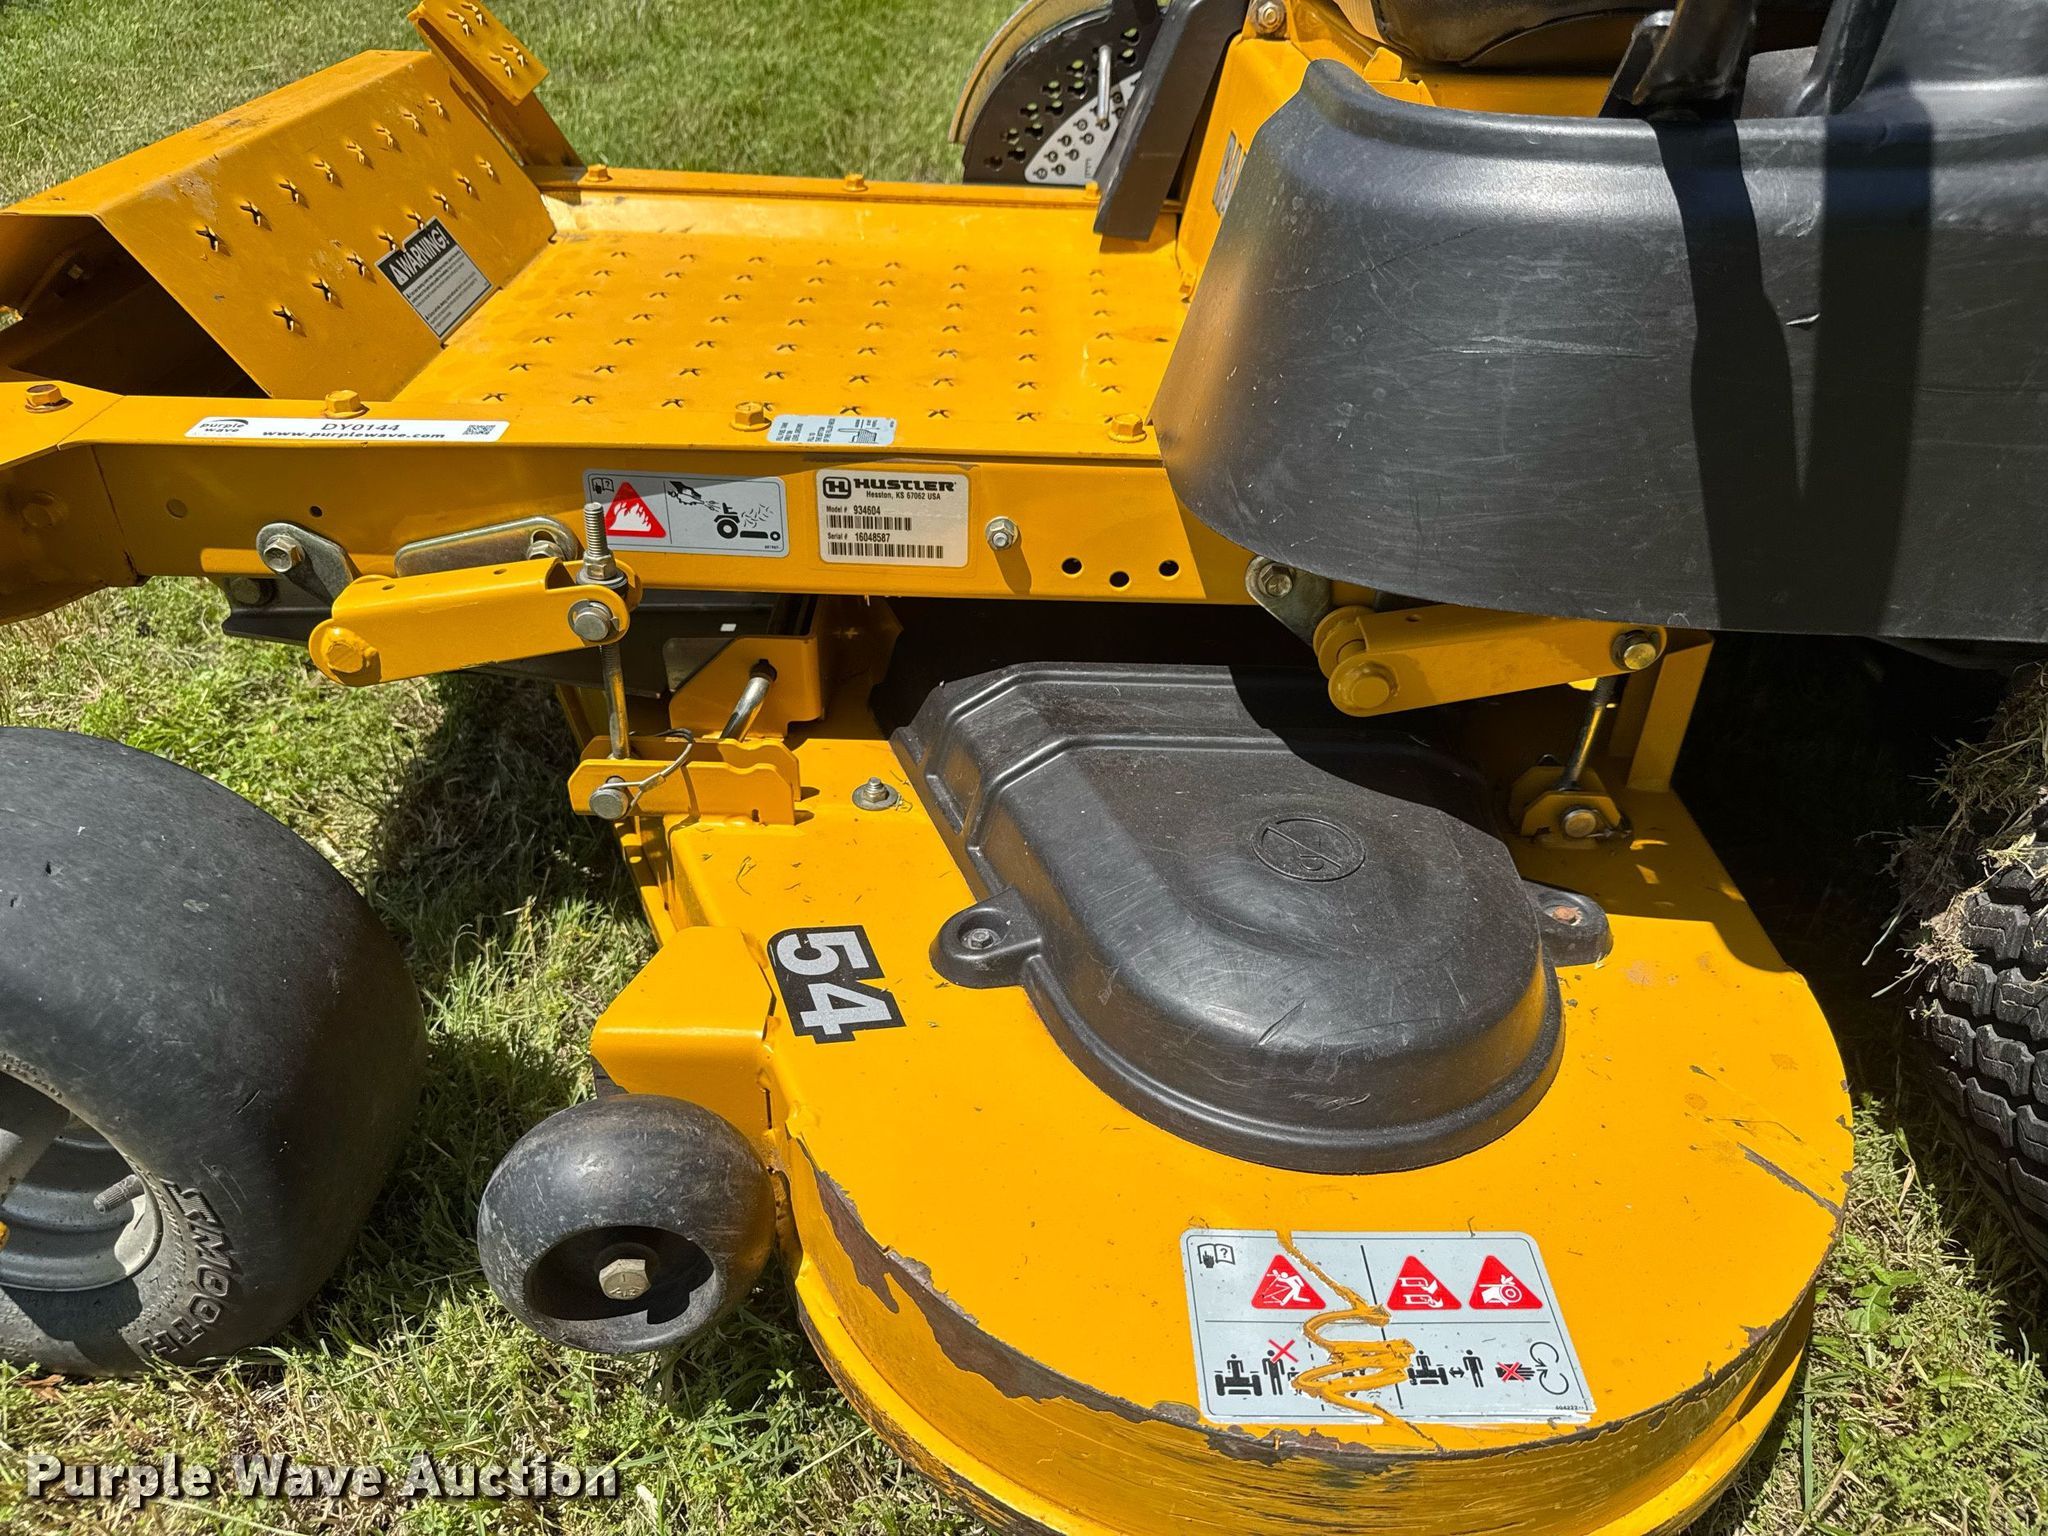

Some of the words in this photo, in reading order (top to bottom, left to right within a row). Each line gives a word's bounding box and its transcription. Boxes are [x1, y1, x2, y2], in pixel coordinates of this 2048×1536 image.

[395, 225, 450, 278] WARNING!
[321, 423, 400, 431] DY0144
[853, 478, 955, 491] HUSTLER
[866, 490, 894, 500] Hesston,
[895, 490, 905, 499] KS
[906, 491, 926, 500] 67062
[927, 492, 941, 501] USA
[826, 505, 843, 513] Model
[827, 532, 843, 540] Serial
[855, 532, 891, 543] 16048587
[776, 930, 893, 1036] 54
